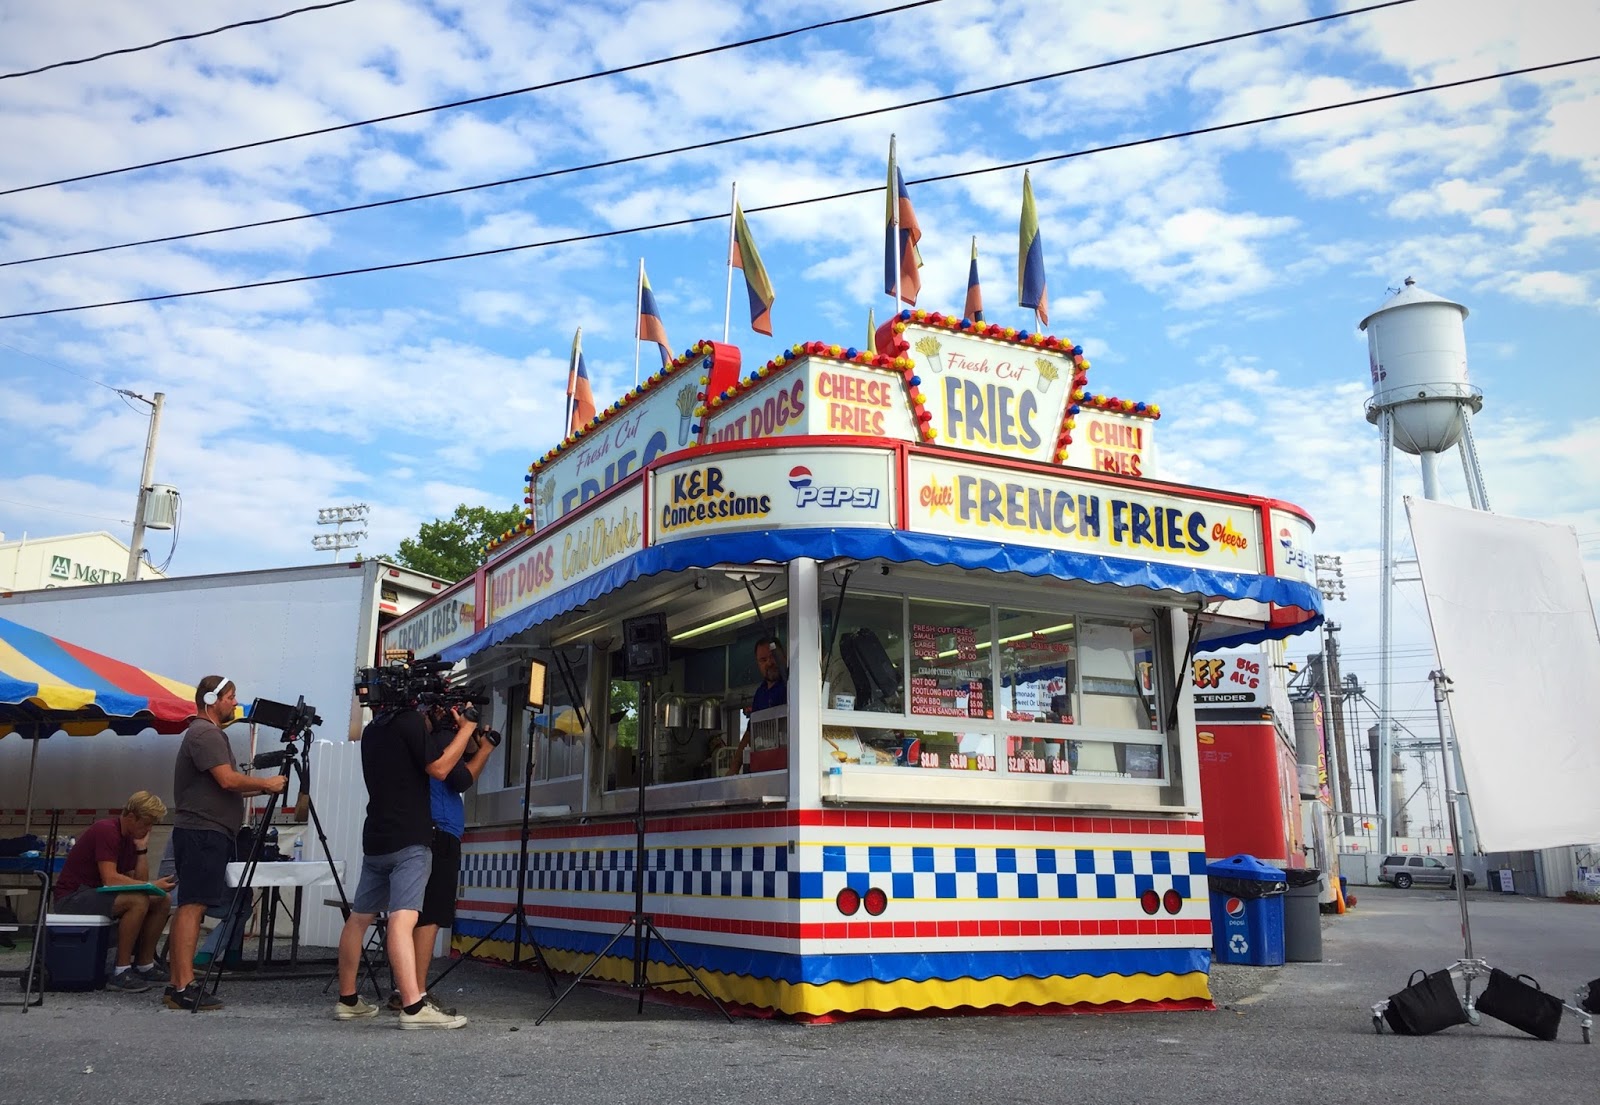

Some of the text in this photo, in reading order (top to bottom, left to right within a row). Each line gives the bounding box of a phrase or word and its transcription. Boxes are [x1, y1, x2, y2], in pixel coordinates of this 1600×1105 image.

[946, 352, 1030, 382] Fresh Cut
[818, 371, 892, 408] CHEESE
[751, 378, 805, 439] DOGS
[829, 402, 887, 436] FRIES
[945, 376, 1041, 451] FRIES
[575, 434, 610, 477] Fresh
[614, 410, 649, 449] Cut
[1089, 420, 1143, 450] CHILI
[1093, 448, 1143, 477] FRIES
[673, 467, 725, 505] K&R
[795, 486, 881, 509] PEPSI
[663, 490, 771, 529] Concessions
[919, 475, 1248, 554] Chili FRENCH FRIES Cheese
[492, 505, 642, 611] HOT DOGS Cold Drinks
[74, 562, 110, 585] M&T
[398, 613, 430, 650] FRENCH
[432, 599, 458, 643] FRIES
[913, 624, 973, 636] FRESH CUT FRIES
[913, 633, 936, 641] SMALL
[914, 641, 936, 649] LARGE
[957, 653, 977, 661] $8.00
[1236, 657, 1260, 675] BIG
[911, 678, 983, 690] HOT DOG $2.50
[1229, 671, 1260, 689] AL'S
[911, 687, 983, 700] FOOTLONG HOT DOG $4.00
[911, 697, 984, 709] PORK BBQ $5.00
[1201, 694, 1247, 702] TENDER
[911, 705, 937, 714] CHICKEN
[937, 707, 967, 716] SANDWICH
[969, 709, 984, 717] $5.00
[920, 751, 1069, 774] $8.00 $6.00 $4.00 $2.00 $3.00 $5.00
[1228, 919, 1246, 927] pepsi
